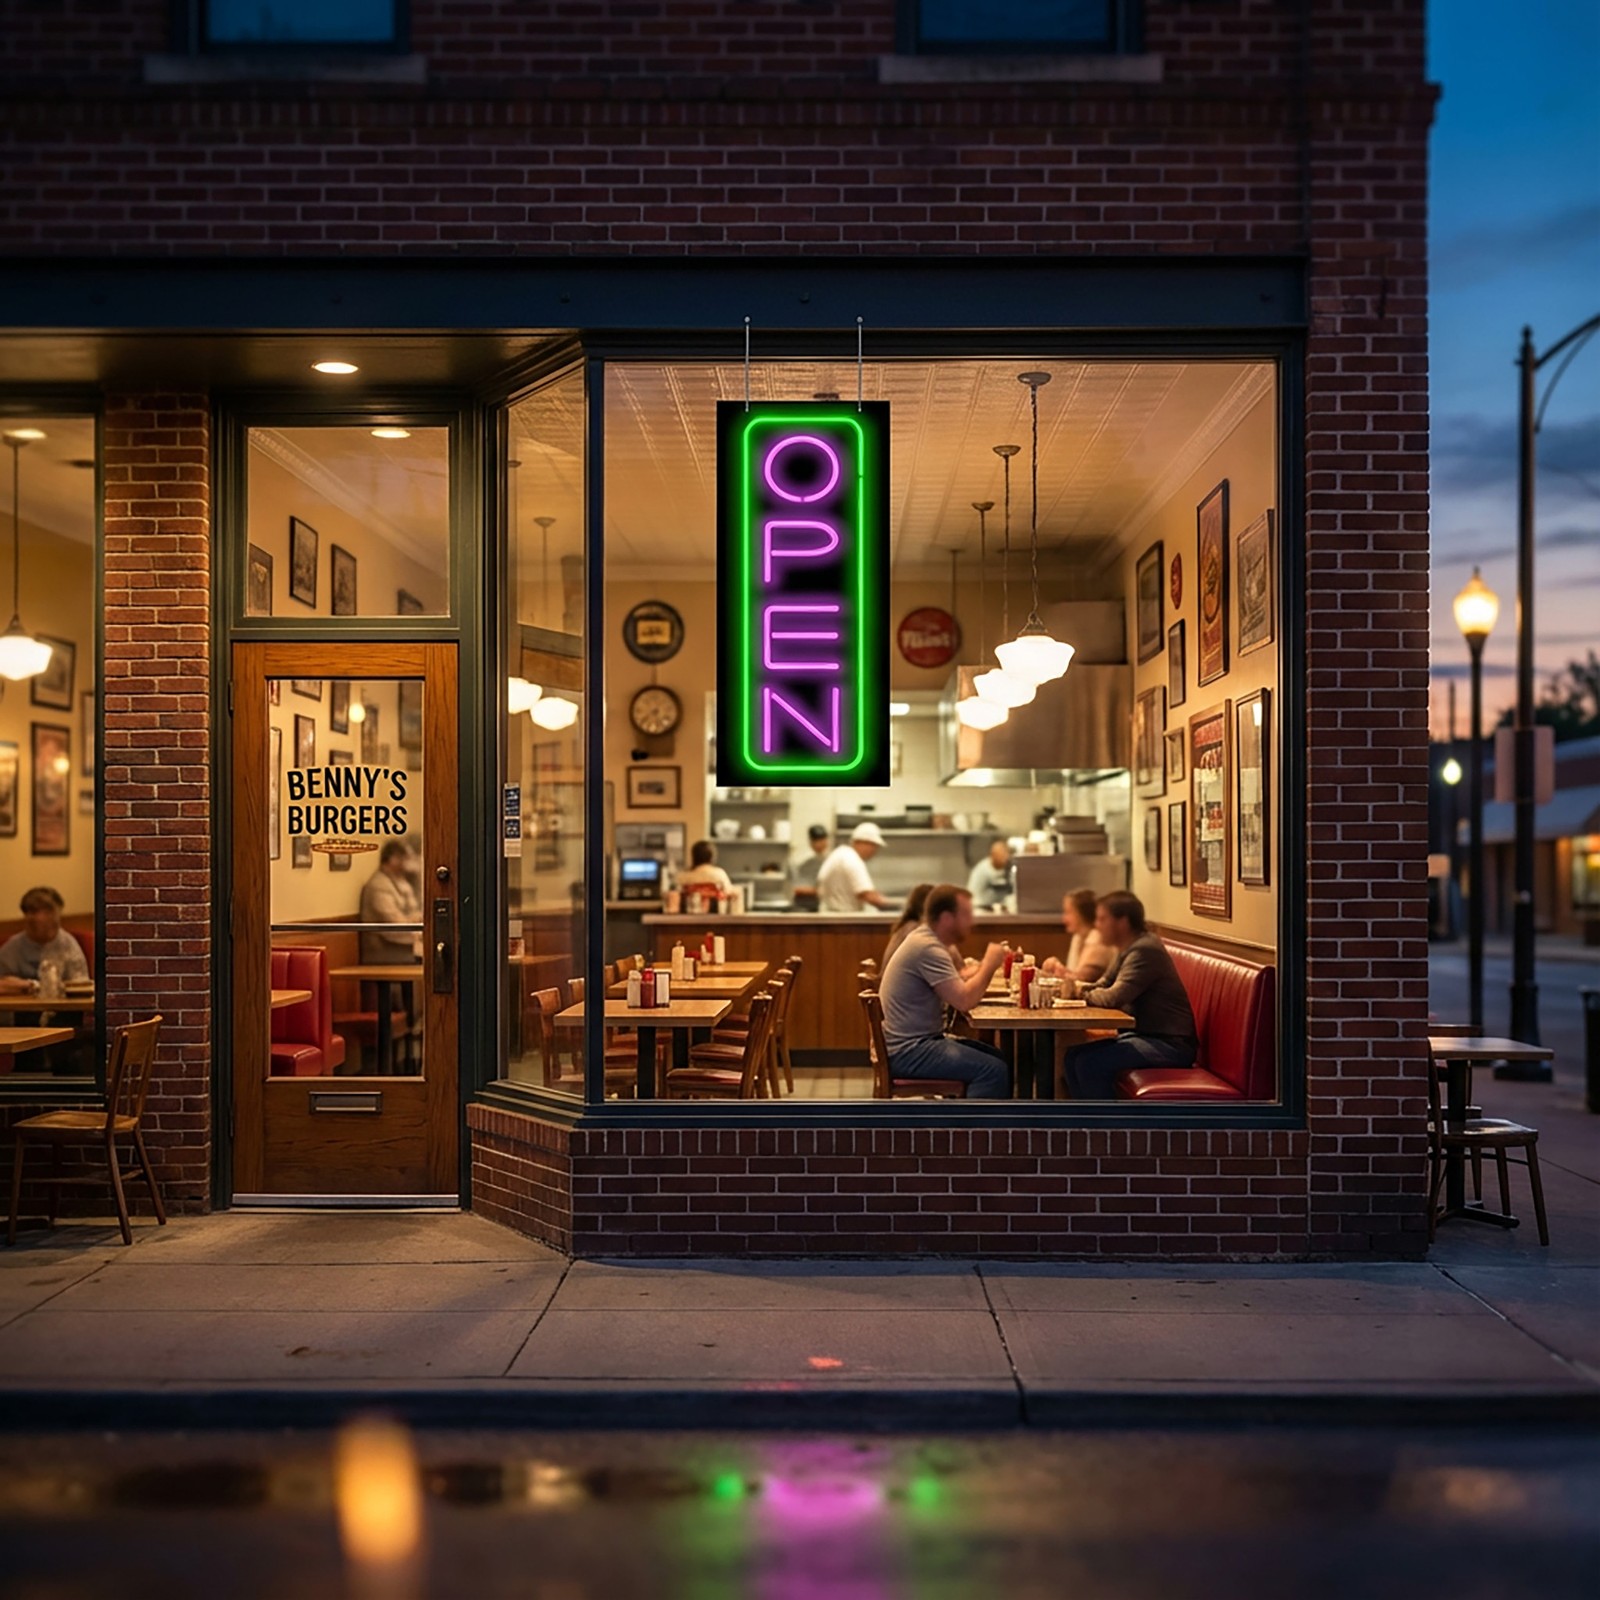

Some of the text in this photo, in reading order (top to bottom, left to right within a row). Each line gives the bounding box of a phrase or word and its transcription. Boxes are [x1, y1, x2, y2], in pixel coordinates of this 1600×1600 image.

[763, 434, 840, 754] OPEN
[287, 767, 407, 801] BENNY'S
[288, 805, 407, 835] BURGERS
